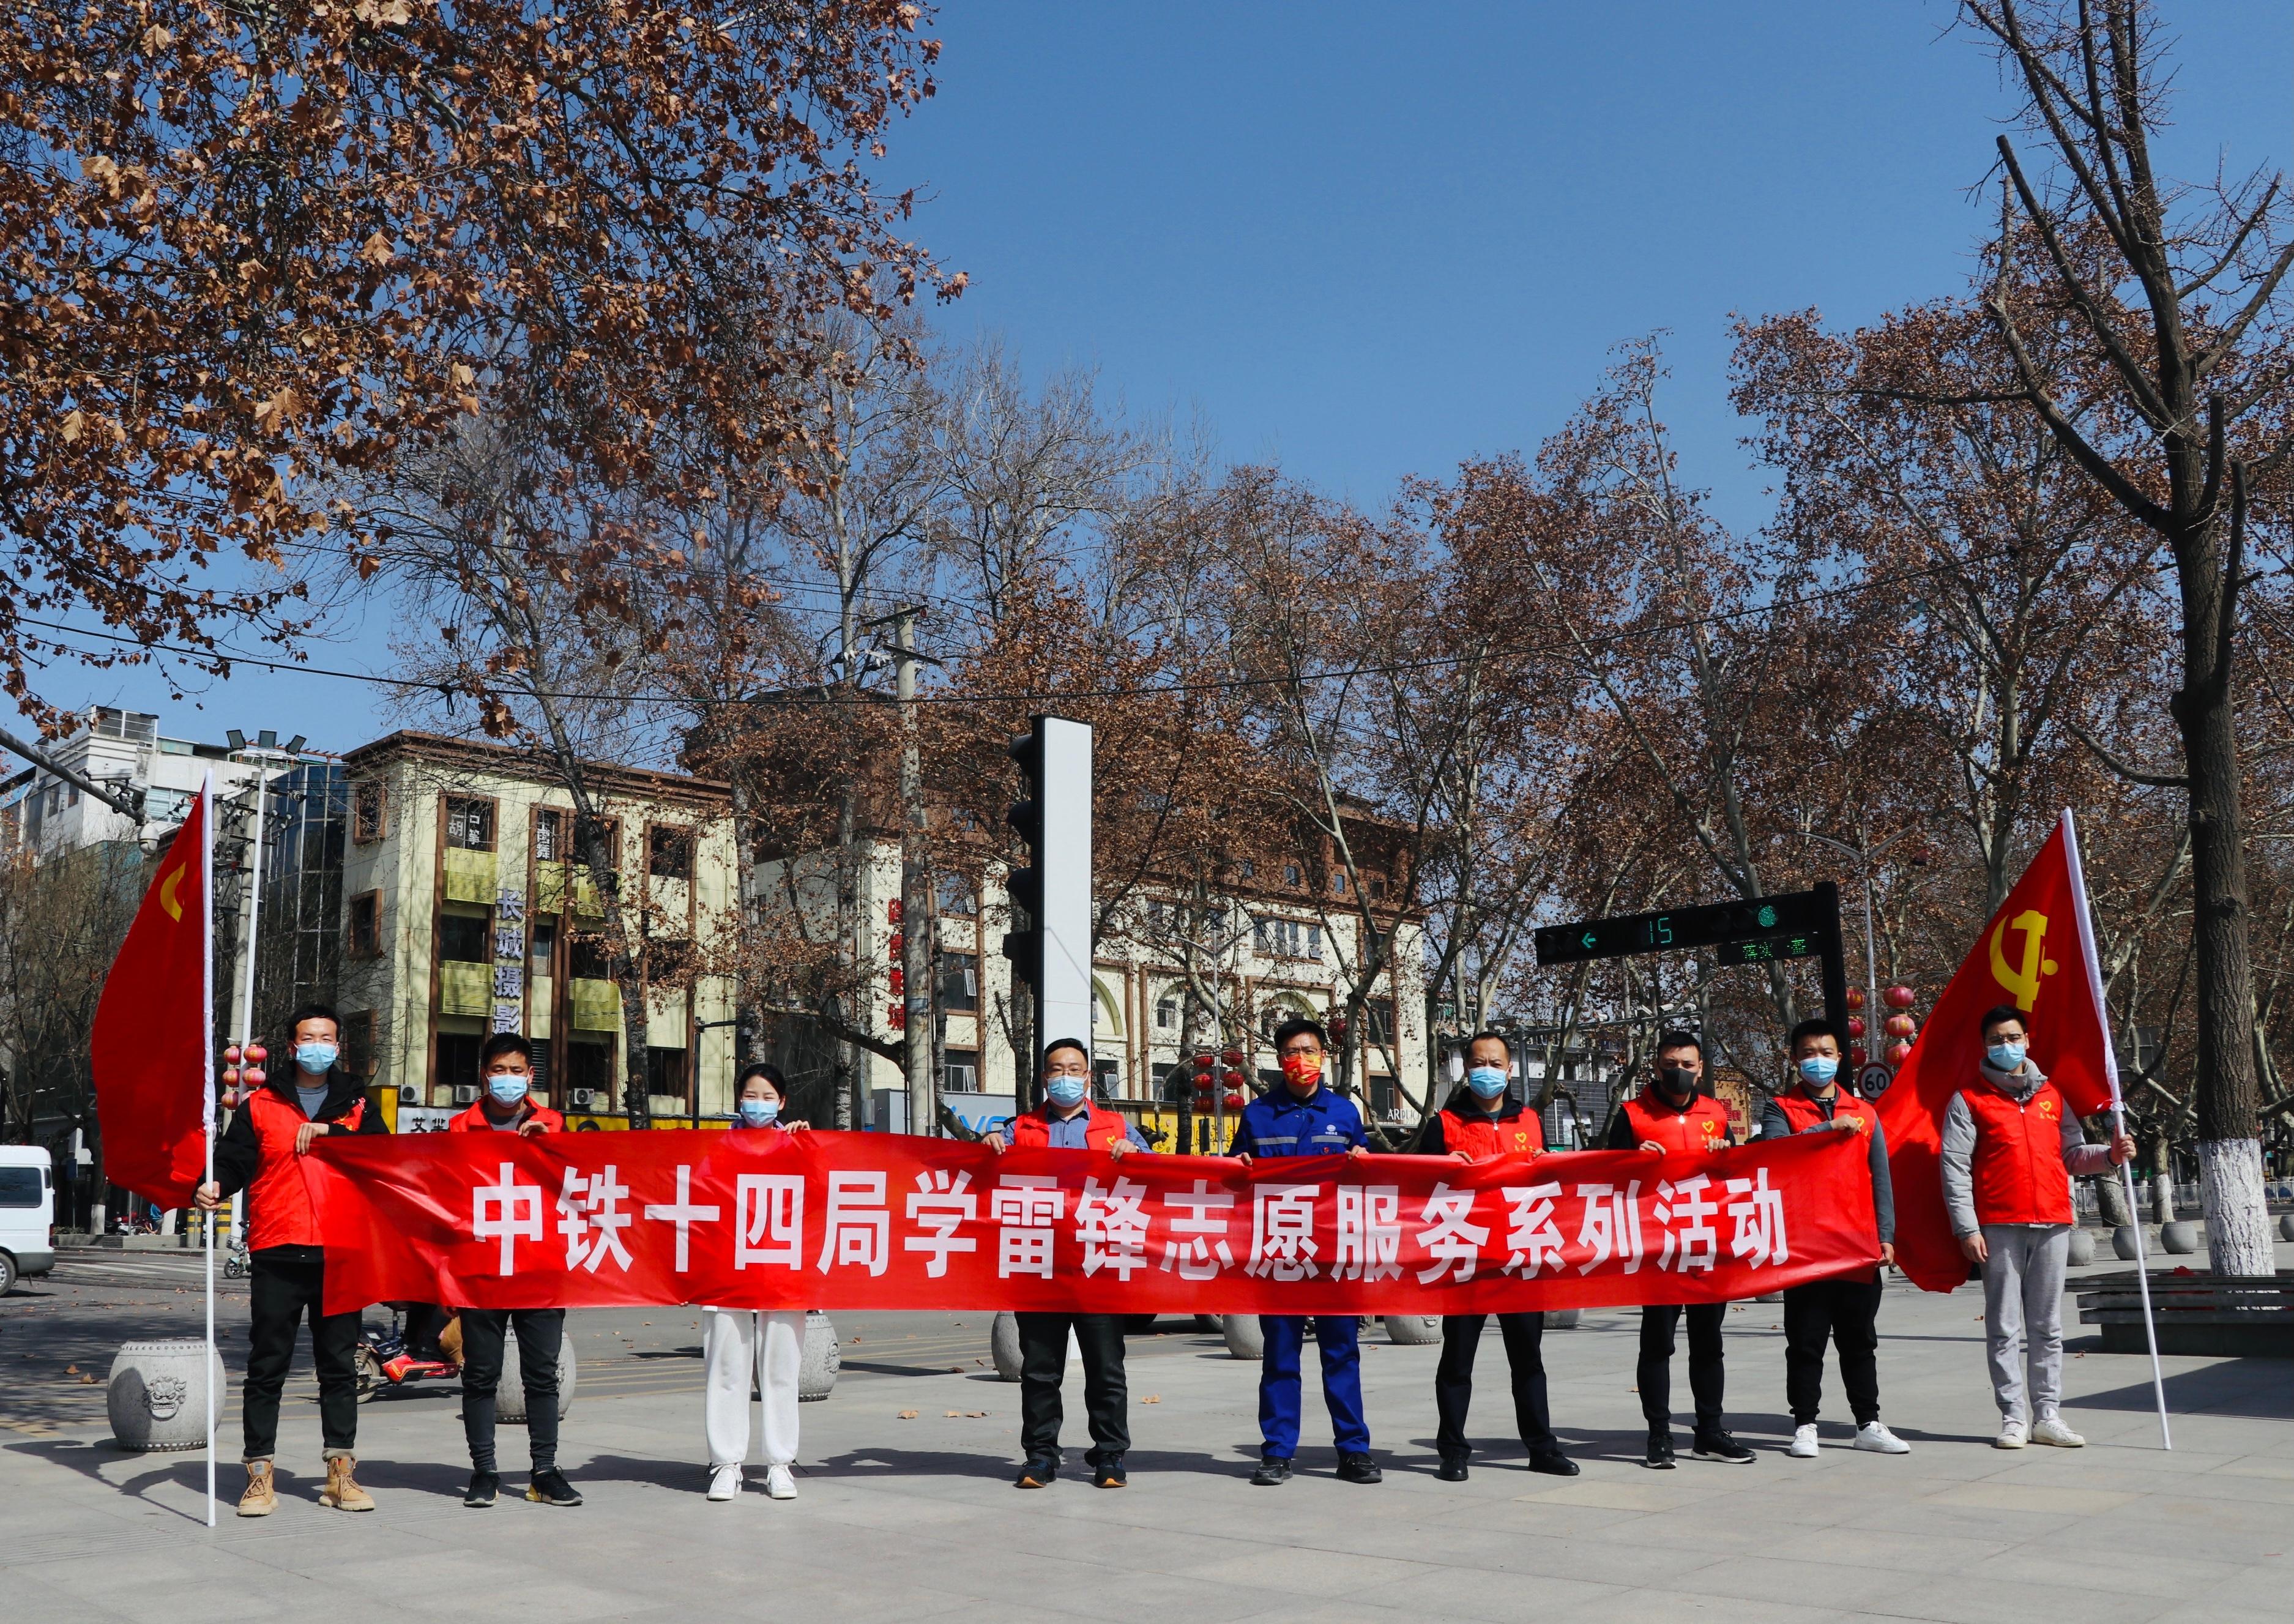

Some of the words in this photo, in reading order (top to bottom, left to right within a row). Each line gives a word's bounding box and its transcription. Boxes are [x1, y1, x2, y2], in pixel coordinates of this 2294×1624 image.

[492, 888, 524, 1034] 长城摄影
[1650, 917, 1672, 943] 15
[1864, 1072, 1886, 1092] 60
[472, 1161, 1789, 1284] 中铁十四局学雷锋志愿服务系列活动
